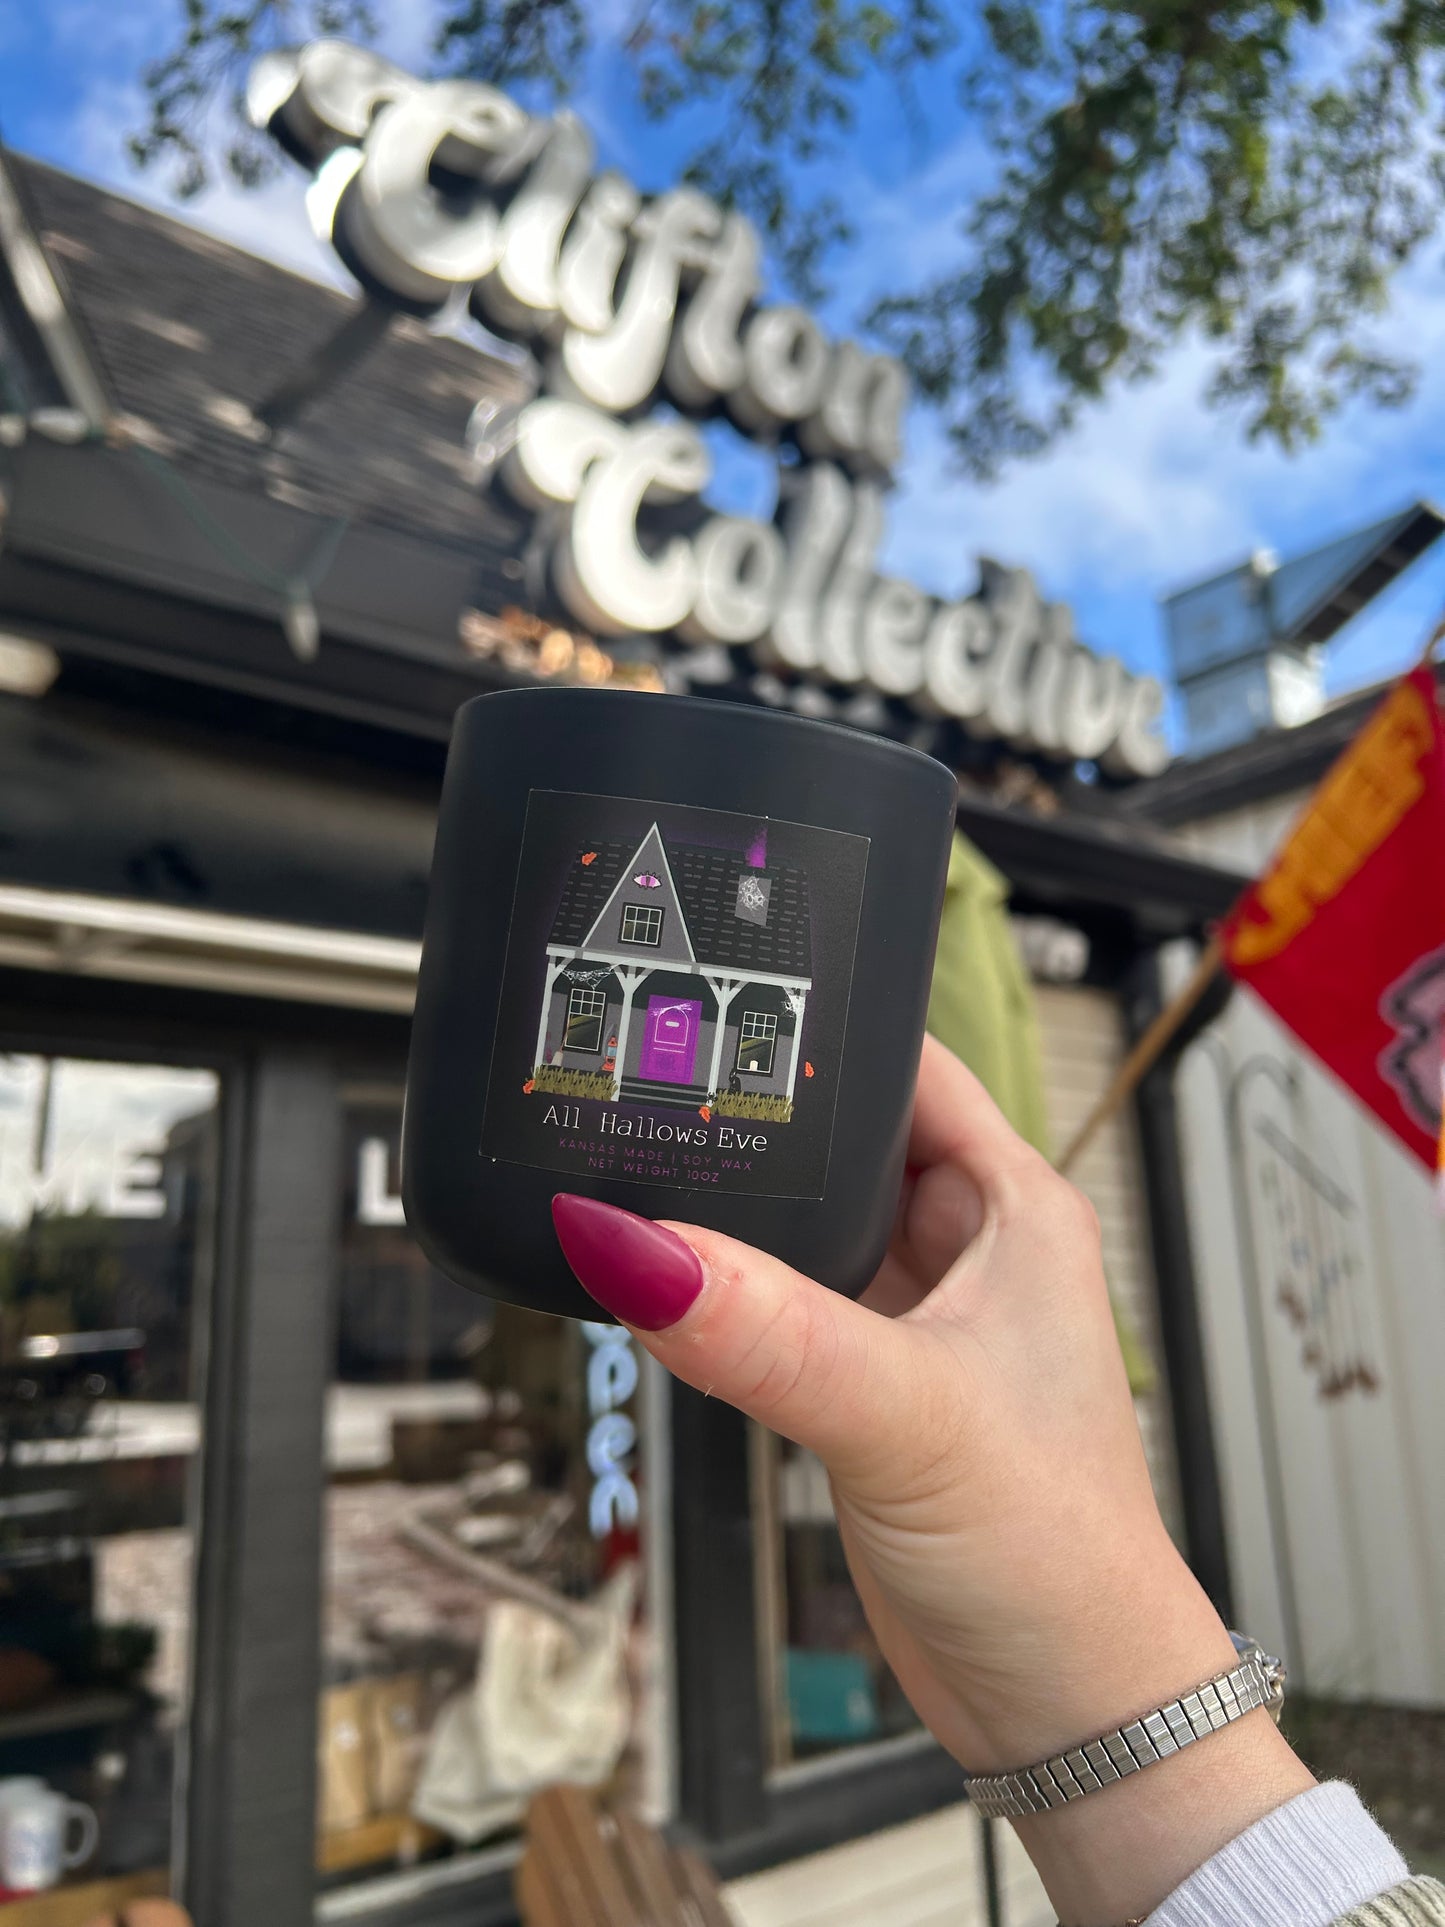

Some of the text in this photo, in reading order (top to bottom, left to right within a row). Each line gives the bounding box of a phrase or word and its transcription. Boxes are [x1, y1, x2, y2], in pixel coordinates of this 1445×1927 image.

[247, 38, 910, 478] Clifton
[515, 396, 1170, 778] Collective
[543, 1105, 768, 1151] All Hallows Eve
[559, 1138, 616, 1155] KANSAS
[624, 1147, 664, 1161] MADE
[683, 1154, 712, 1166] SOY
[721, 1160, 752, 1171] WAX
[588, 1157, 614, 1169] NET
[623, 1162, 679, 1178] WEIGHT
